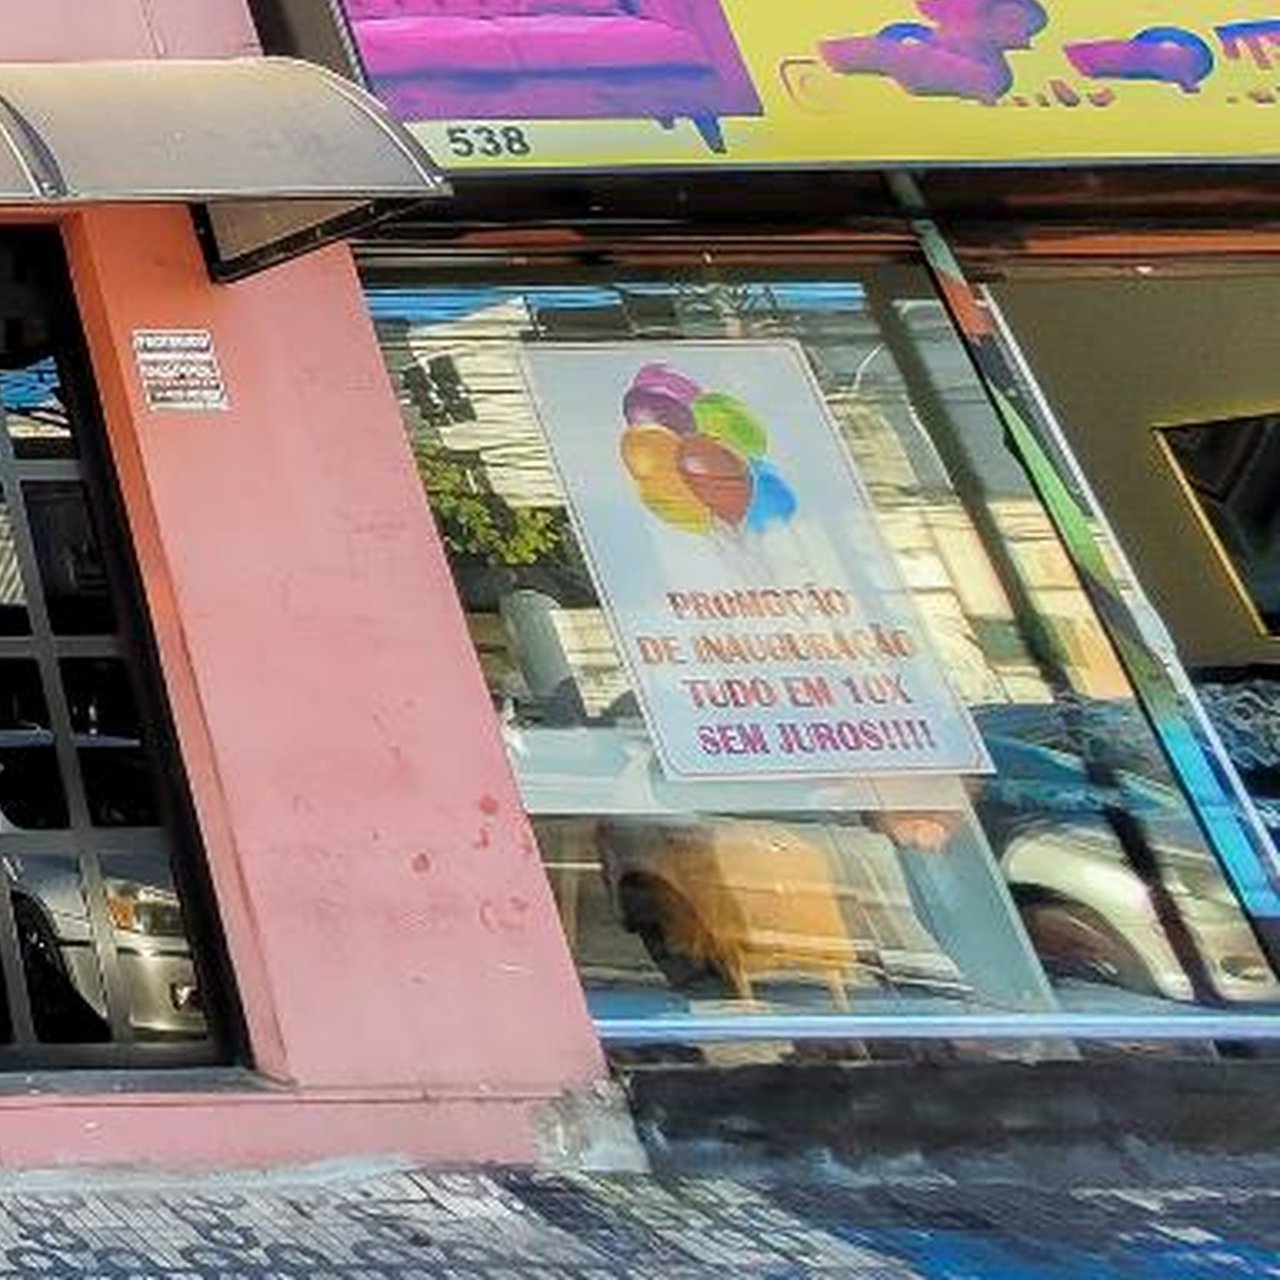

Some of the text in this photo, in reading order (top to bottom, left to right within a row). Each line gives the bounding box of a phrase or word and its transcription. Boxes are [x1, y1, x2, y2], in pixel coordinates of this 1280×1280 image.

[446, 126, 532, 158] 538
[667, 583, 852, 619] PROMOÇÃO
[638, 623, 915, 666] DE INAUGURAÇÃO
[682, 673, 913, 708] TUDO EM 10X
[697, 720, 936, 754] SEM JUROS!!!!
